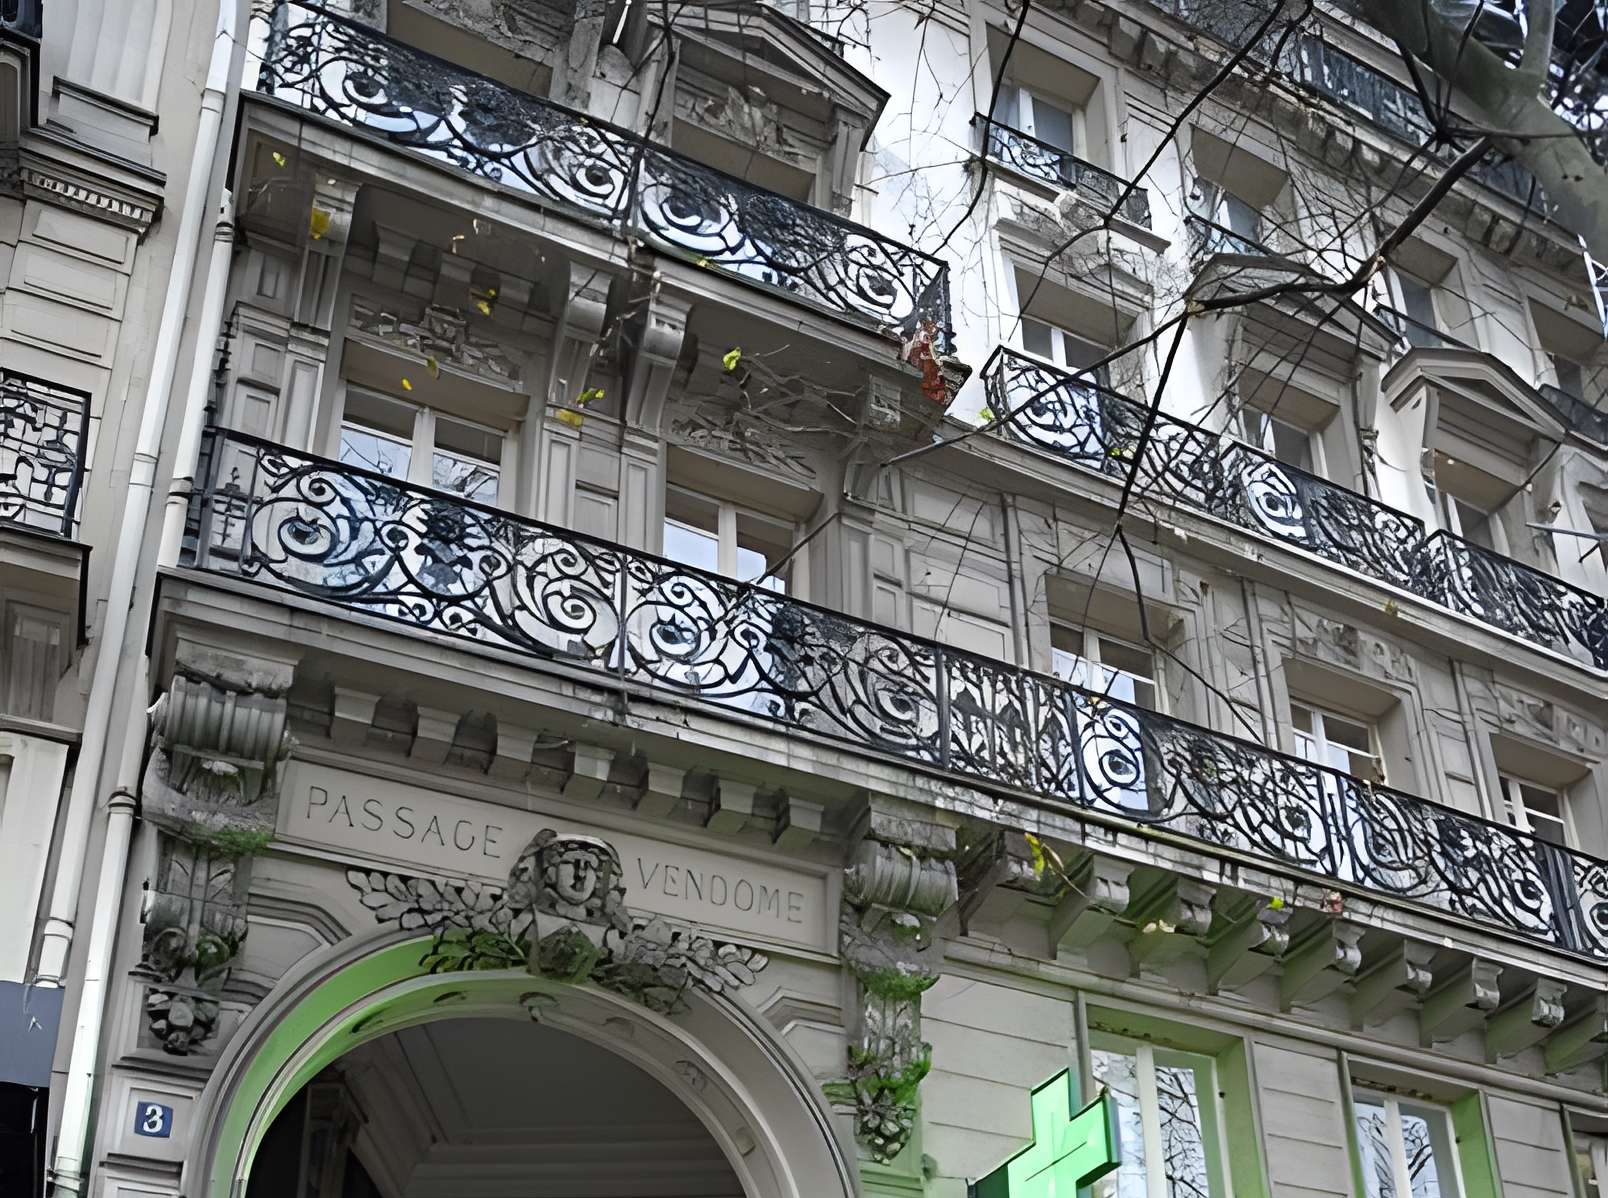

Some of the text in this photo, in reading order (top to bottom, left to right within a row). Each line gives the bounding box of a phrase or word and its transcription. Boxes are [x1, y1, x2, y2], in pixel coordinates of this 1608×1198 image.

[306, 785, 804, 924] PASSAGE VENDOME
[143, 1104, 163, 1133] 3
